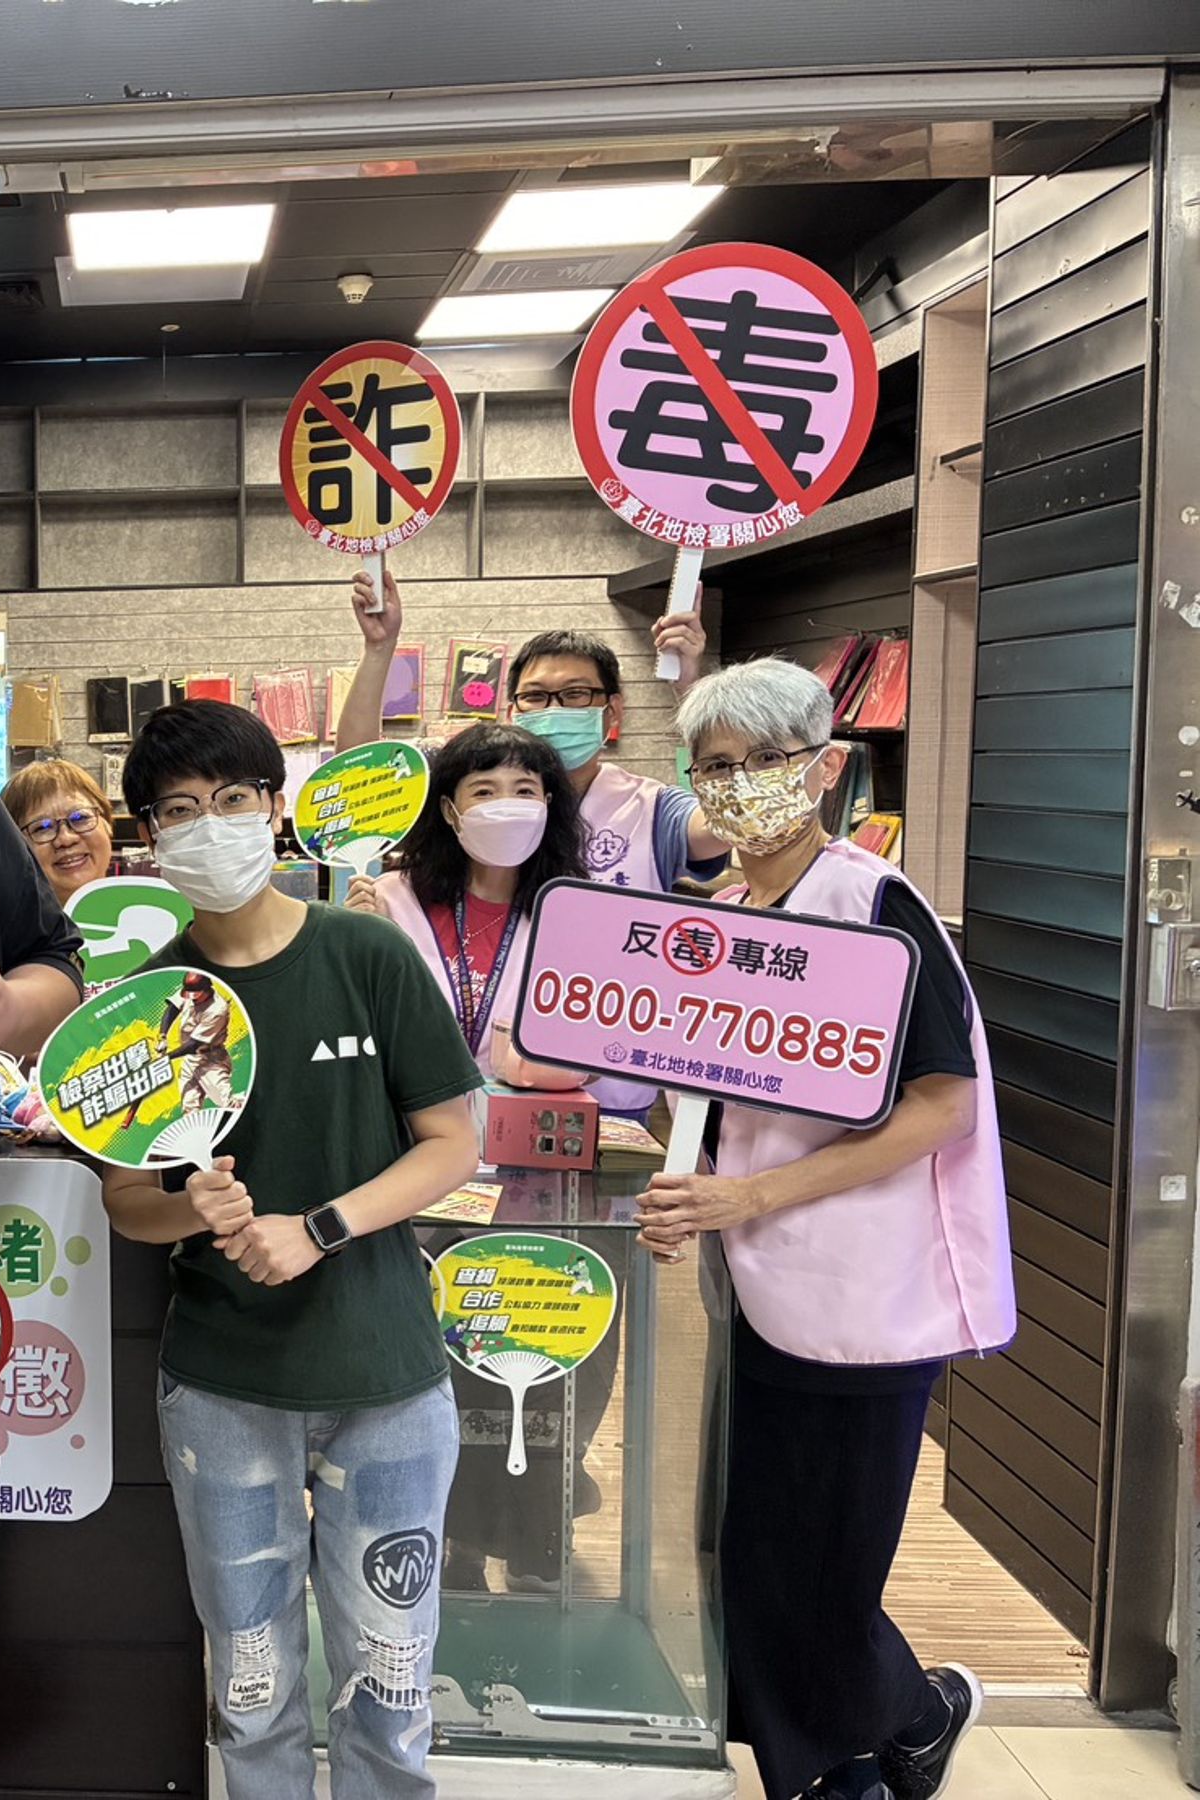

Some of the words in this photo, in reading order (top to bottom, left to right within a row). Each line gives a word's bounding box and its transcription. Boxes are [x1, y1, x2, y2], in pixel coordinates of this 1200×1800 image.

[608, 290, 841, 514] 毒
[304, 373, 435, 525] 詐
[318, 507, 431, 552] 臺北地檢署關心您
[620, 500, 806, 548] 臺北地檢署關心您
[621, 918, 809, 982] 反毒專線
[532, 969, 888, 1080] 0800-770885
[58, 1040, 150, 1109] 檢察出擊
[81, 1055, 173, 1127] 詐騙出局
[629, 1048, 784, 1094] 臺北地檢署關心您
[461, 1290, 503, 1309] 合作
[0, 1344, 72, 1418] 懲
